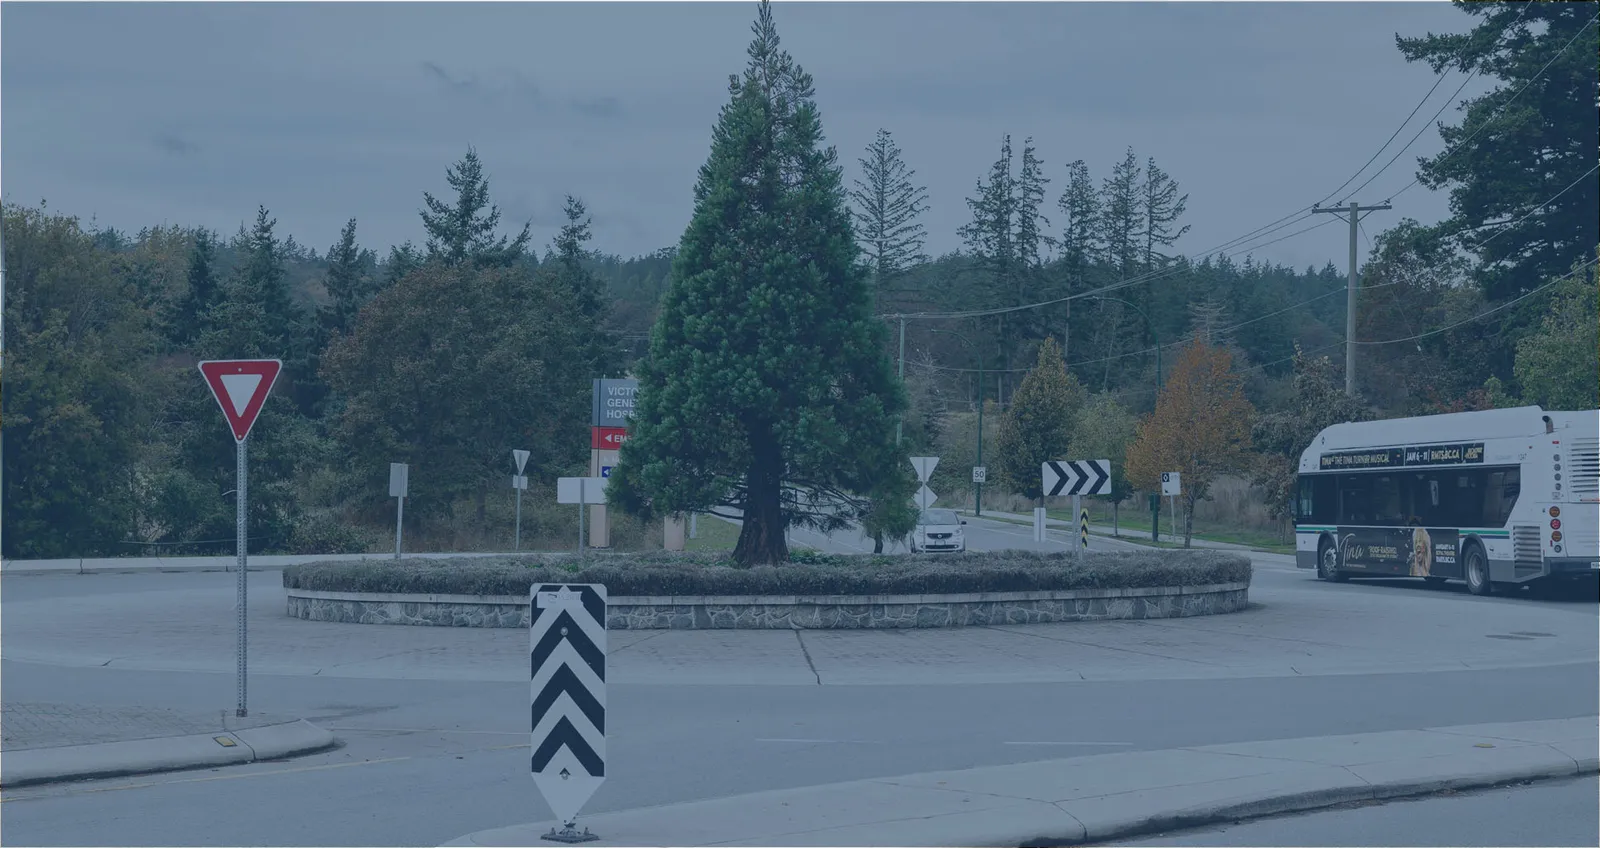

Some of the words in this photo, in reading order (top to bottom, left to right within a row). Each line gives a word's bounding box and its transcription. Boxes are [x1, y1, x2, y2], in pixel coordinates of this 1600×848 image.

[608, 387, 639, 396] VICTO
[607, 398, 636, 408] GENE
[606, 409, 635, 419] HOSP
[1406, 451, 1416, 462] JAN
[1339, 532, 1365, 567] Tina
